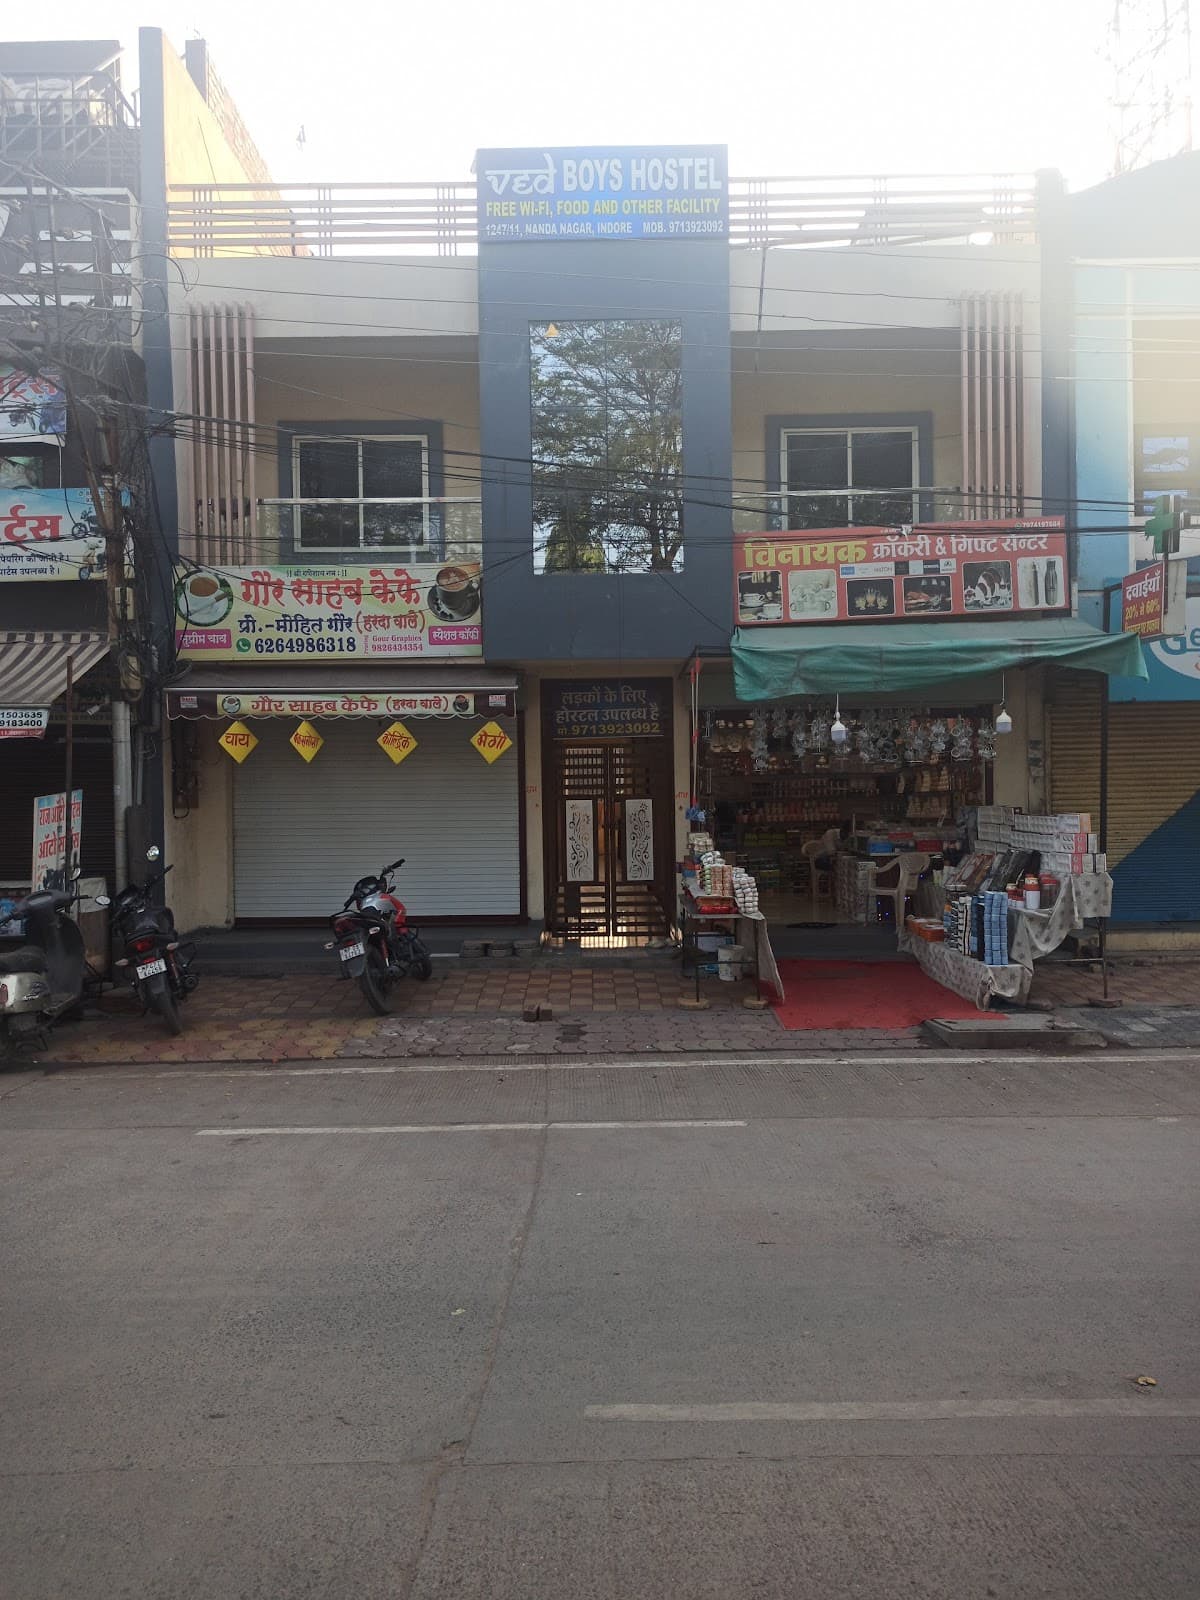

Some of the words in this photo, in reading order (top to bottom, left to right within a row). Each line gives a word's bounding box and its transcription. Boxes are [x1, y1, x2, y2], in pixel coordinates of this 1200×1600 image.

[562, 157, 623, 192] BOYS
[631, 156, 723, 191] HOSTEL
[486, 201, 516, 217] FREE
[556, 199, 589, 215] FOOD
[593, 199, 618, 215] AND
[623, 198, 663, 214] OTHER
[667, 198, 721, 213] FACILITY
[597, 221, 633, 234] INDORE
[643, 221, 667, 233] MOB.
[743, 537, 867, 568] विनायक
[935, 536, 947, 555] &
[240, 570, 285, 607] गौर
[290, 577, 364, 610] साहब
[326, 613, 353, 632] गौर
[254, 636, 356, 653] 6264986318
[251, 695, 286, 712] गौर
[288, 699, 338, 714] साहब
[604, 686, 617, 704] के
[225, 733, 251, 748] चाय
